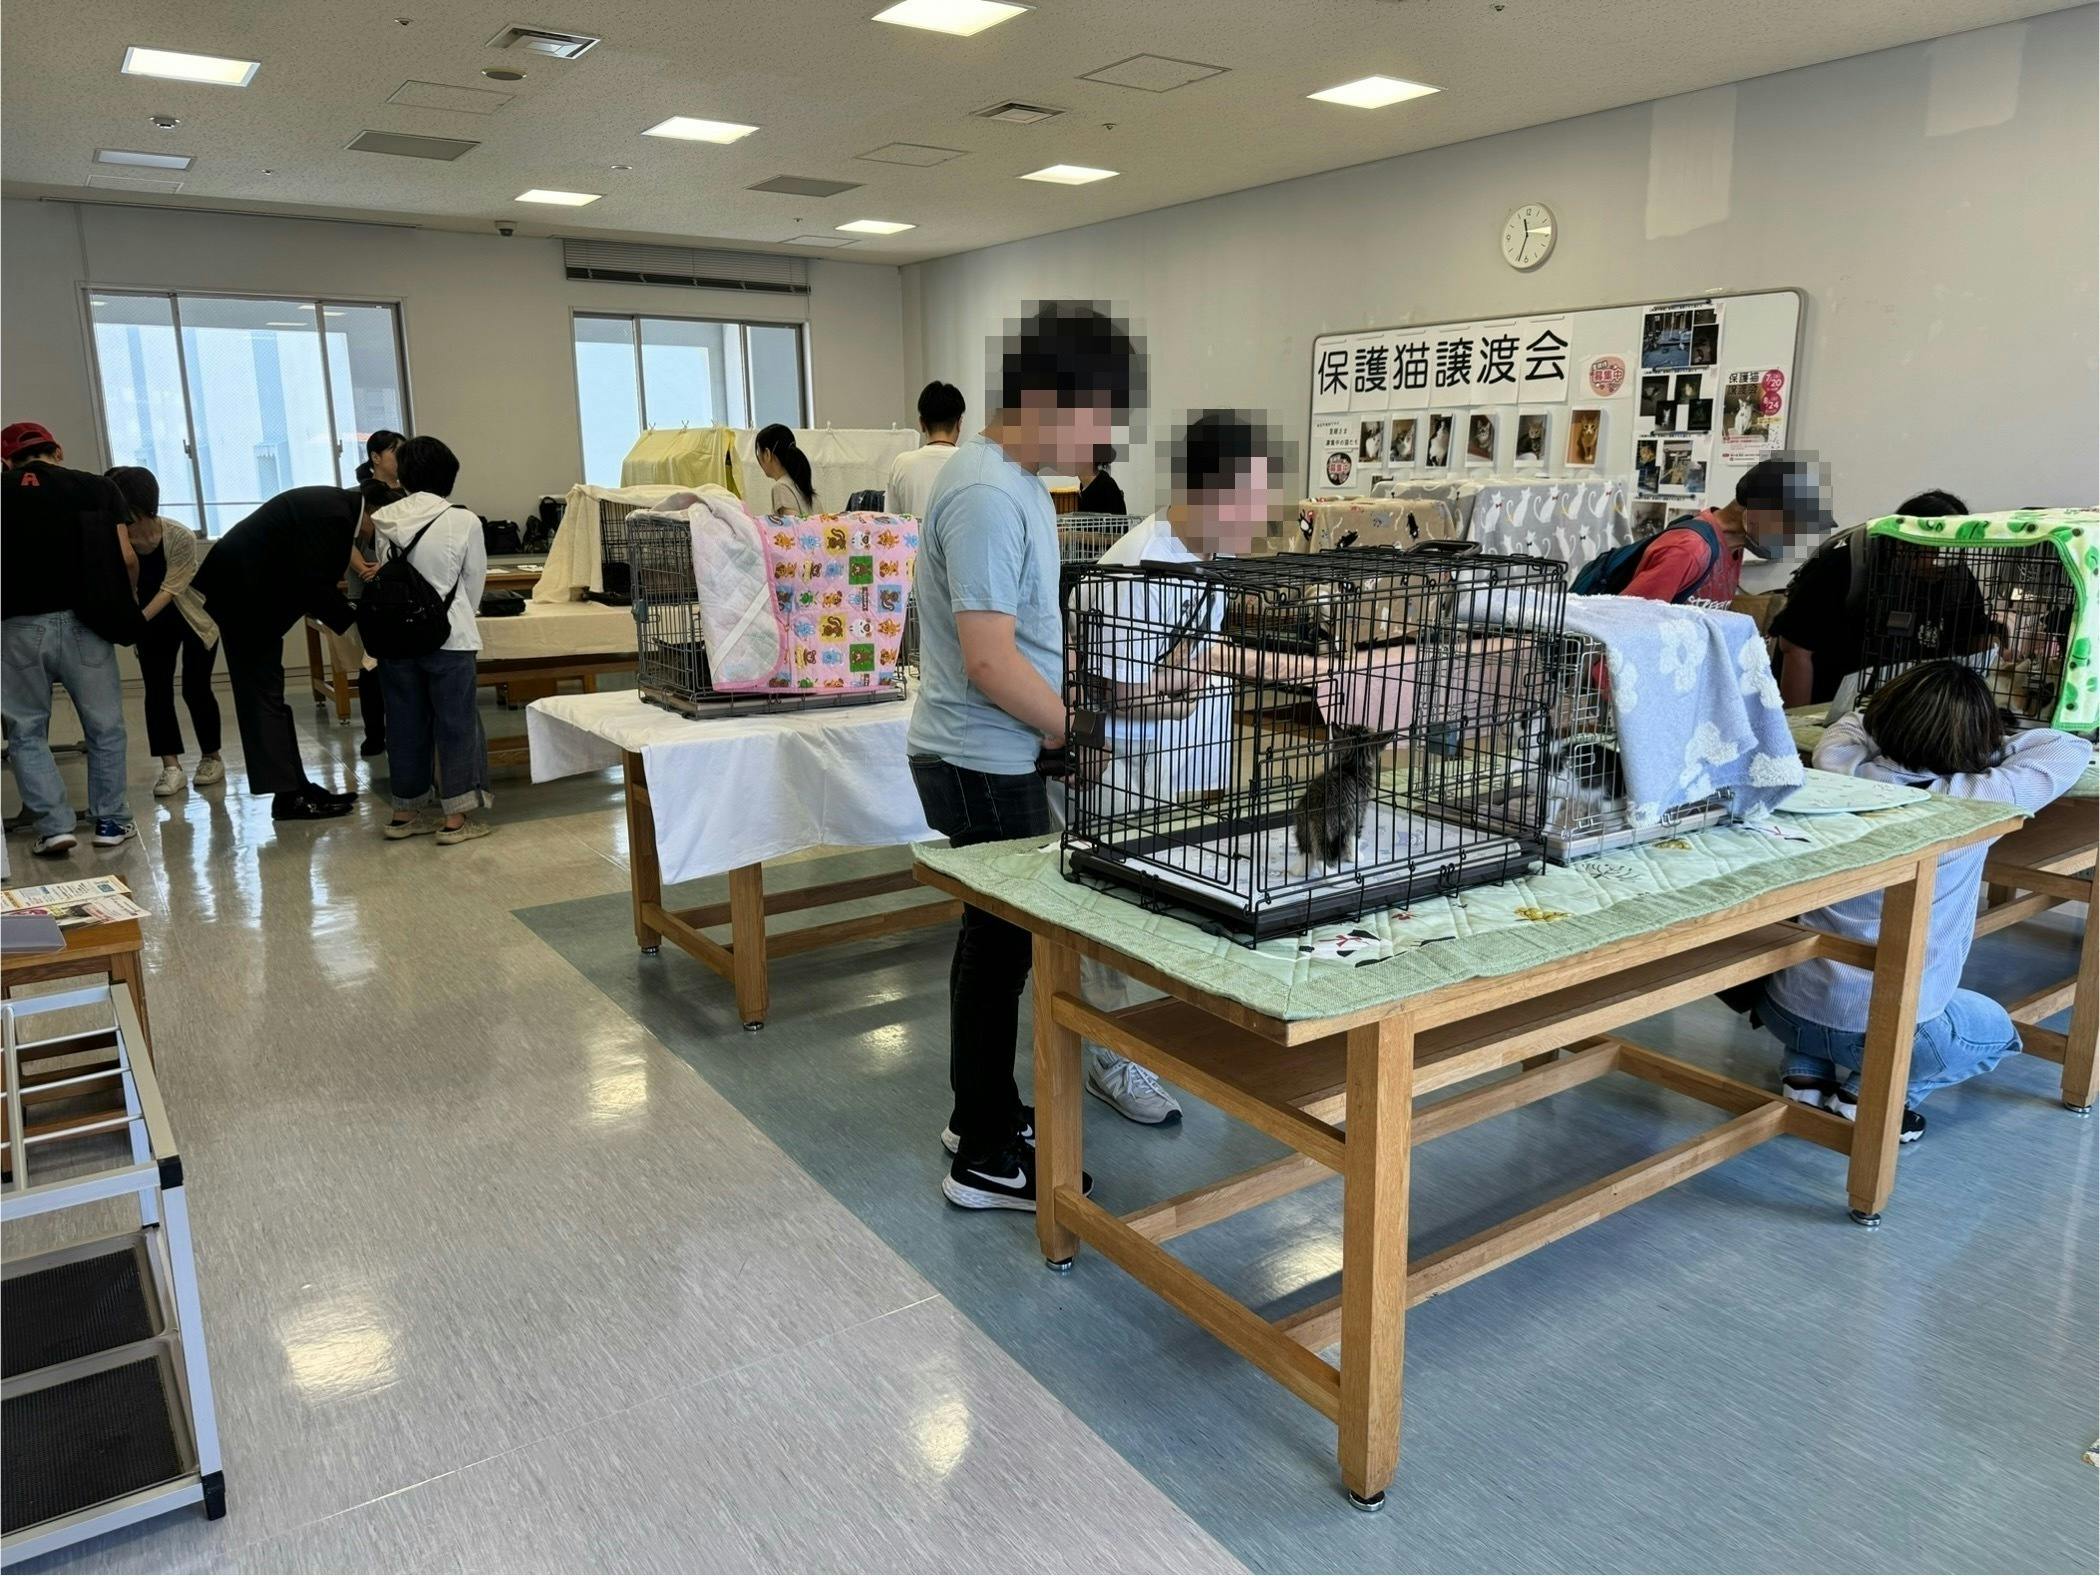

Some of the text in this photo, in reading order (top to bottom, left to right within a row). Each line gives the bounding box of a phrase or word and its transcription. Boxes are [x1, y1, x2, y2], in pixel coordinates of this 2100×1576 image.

[1318, 329, 1568, 395] 保護猫譲渡会
